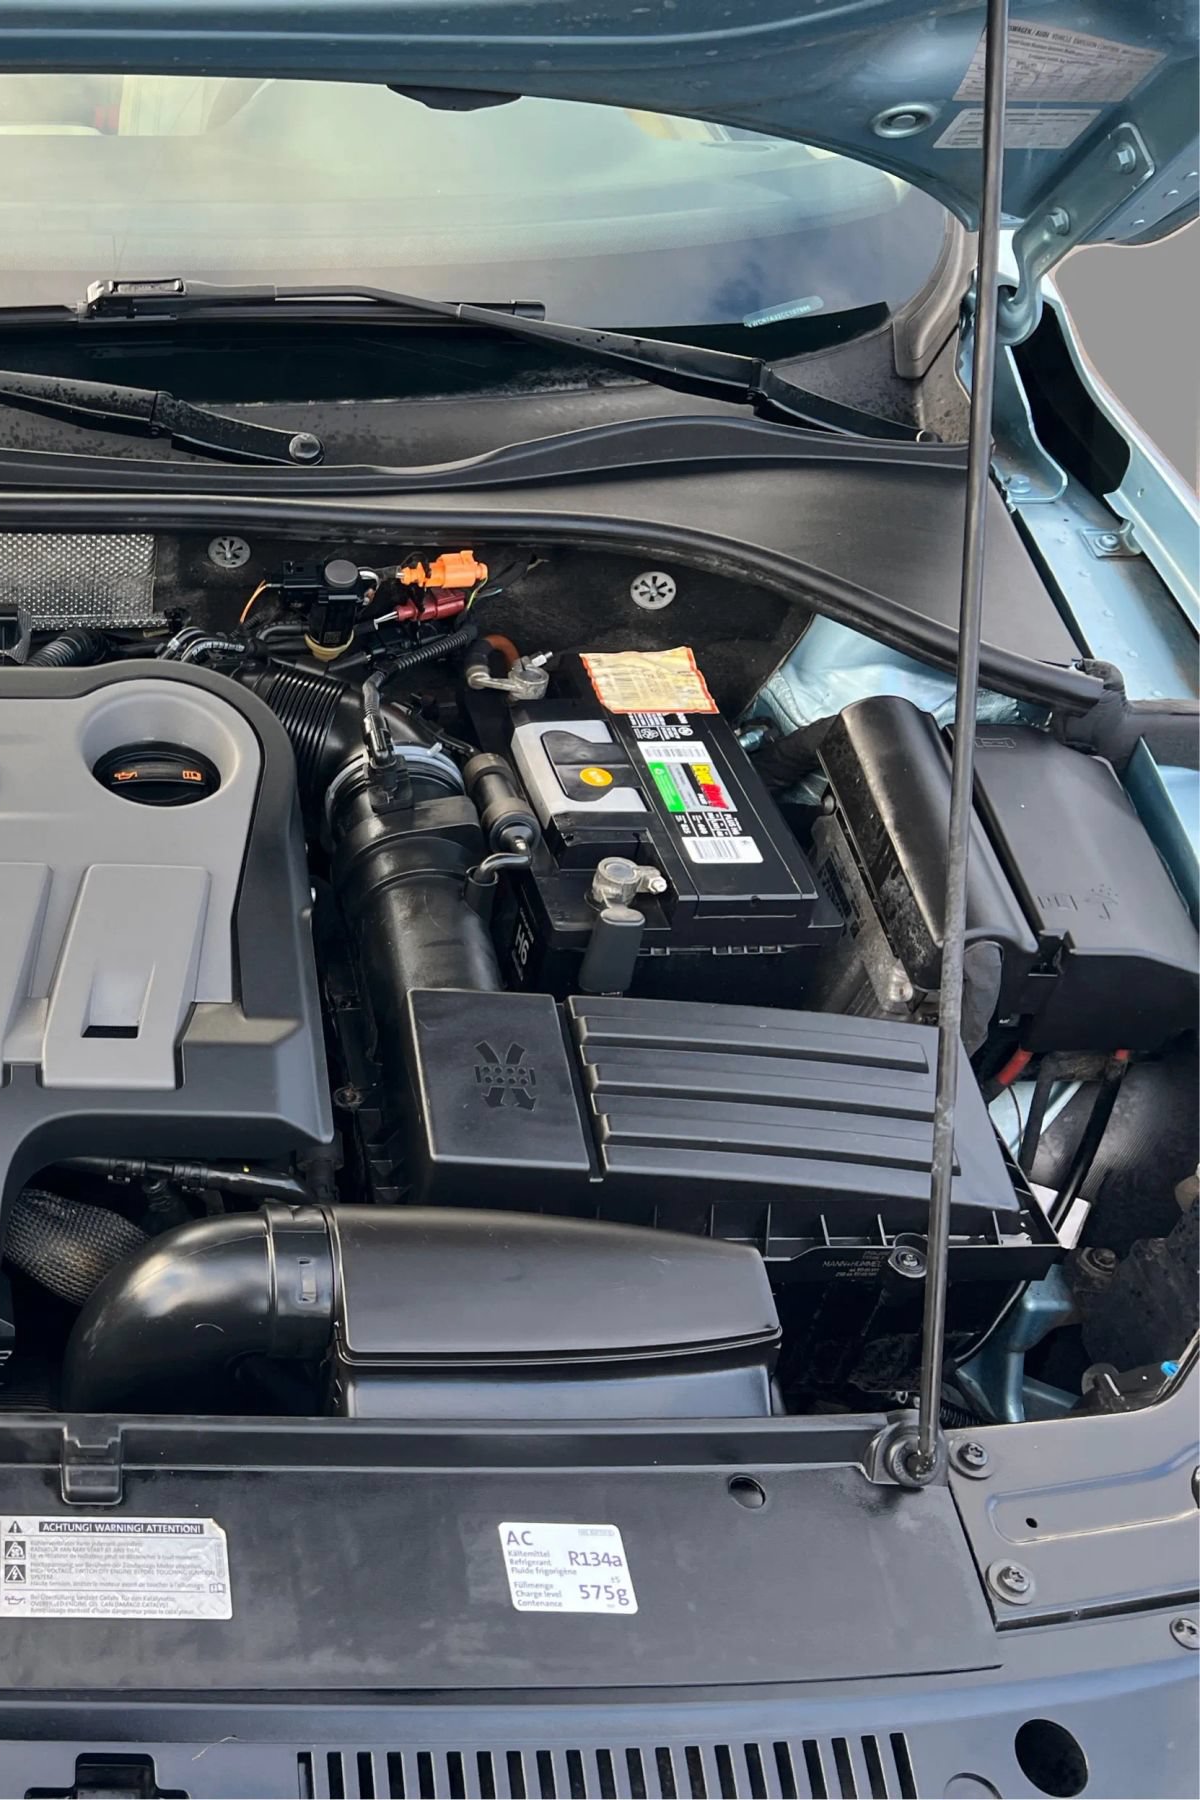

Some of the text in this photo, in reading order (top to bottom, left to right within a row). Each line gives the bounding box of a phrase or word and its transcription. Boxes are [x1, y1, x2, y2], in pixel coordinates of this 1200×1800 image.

[42, 1523, 200, 1532] ACHTUNG! WARNING! ATTENTION!
[567, 1550, 623, 1567] R134a
